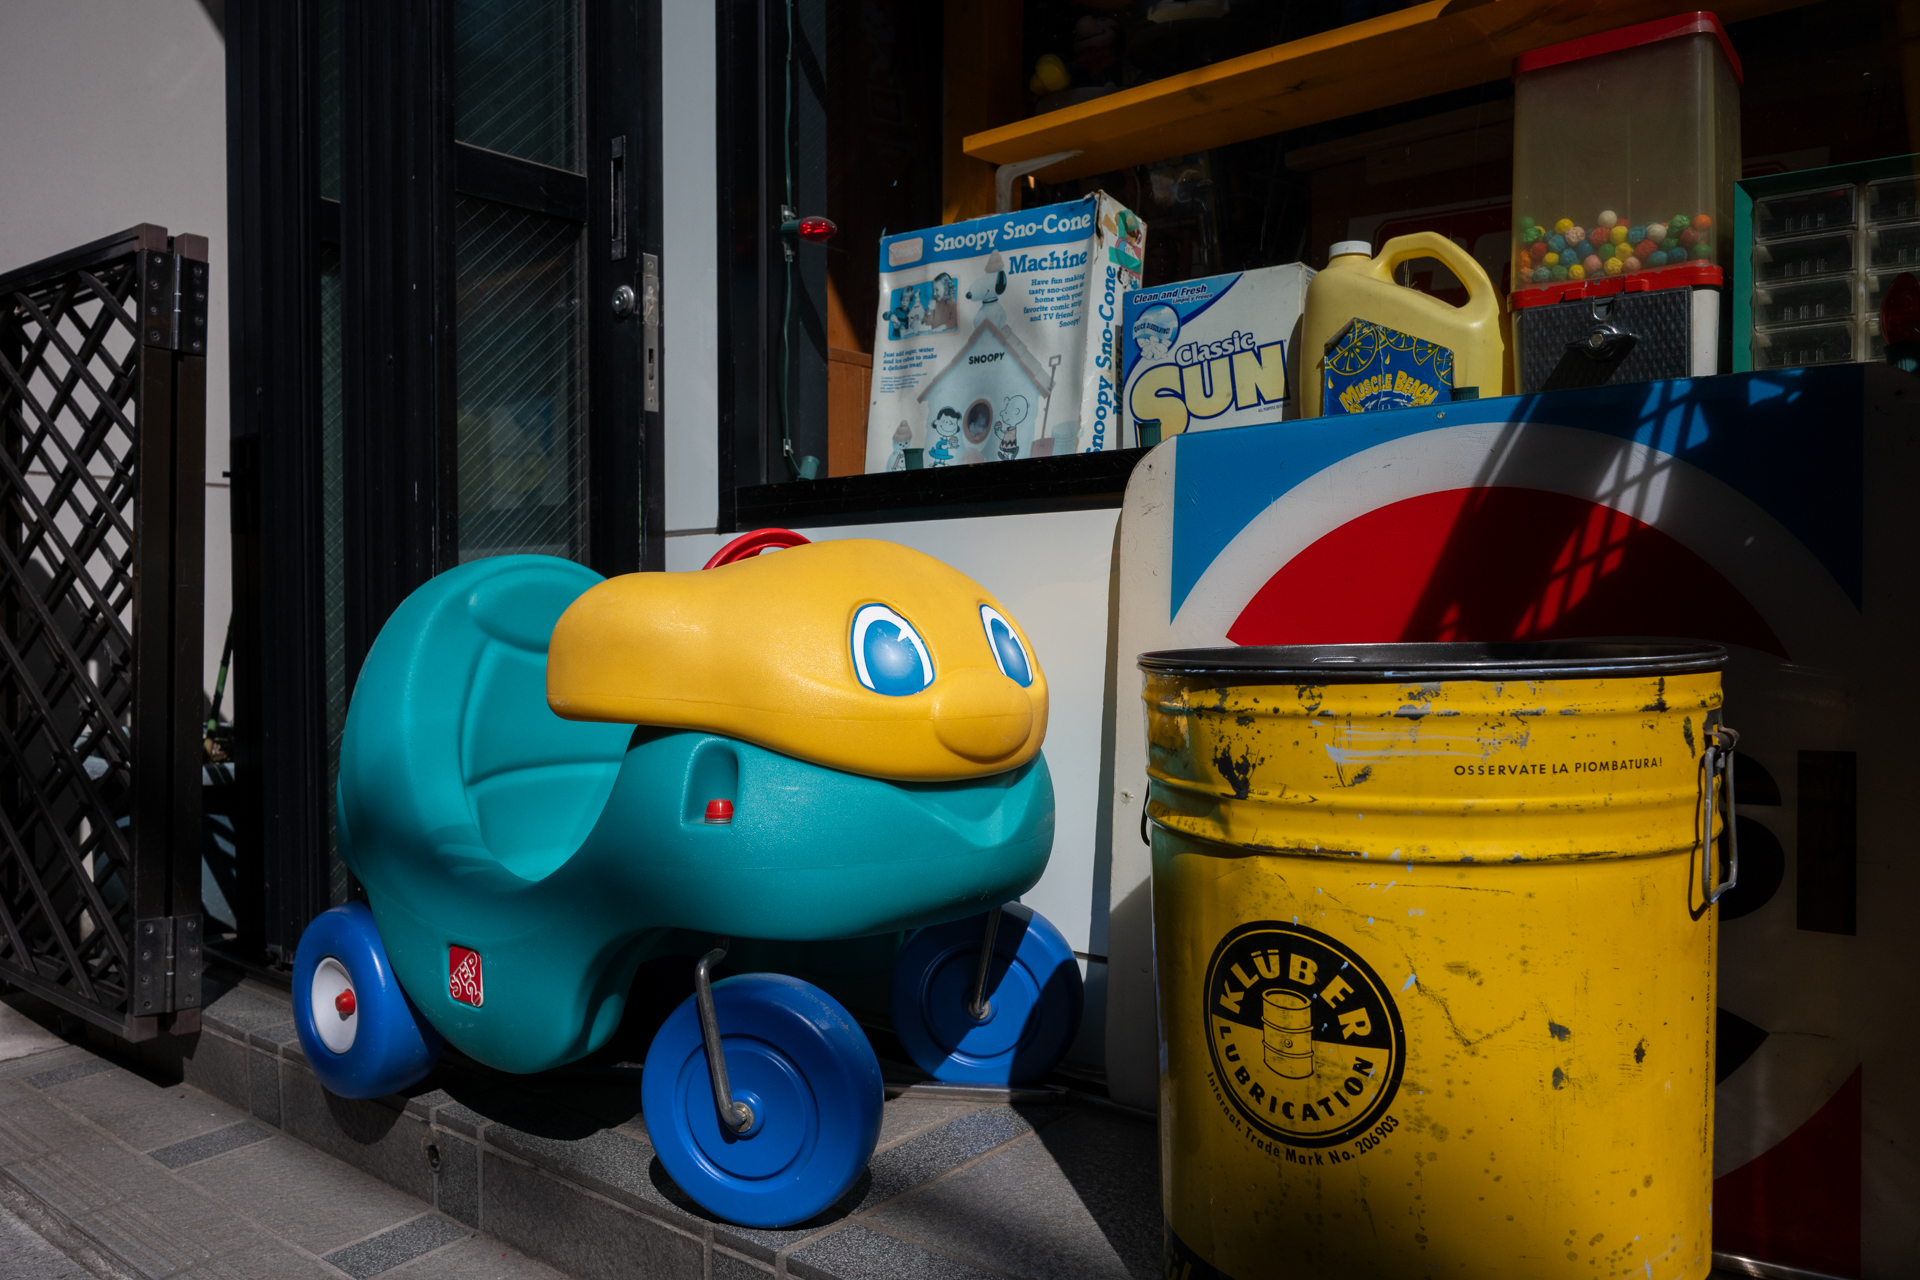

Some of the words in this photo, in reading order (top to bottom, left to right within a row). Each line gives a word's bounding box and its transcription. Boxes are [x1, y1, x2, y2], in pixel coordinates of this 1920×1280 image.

[934, 227, 999, 252] Snoopy
[1003, 213, 1091, 239] Sno-Cone
[1008, 249, 1088, 275] Machine
[1064, 272, 1086, 282] making
[1047, 284, 1079, 294] sno-cones
[1071, 291, 1084, 300] your
[1133, 291, 1159, 305] Clean
[1160, 288, 1179, 300] and
[1180, 283, 1207, 298] Fresh
[1171, 296, 1190, 305] Limpio
[1195, 292, 1214, 301] Fresco
[1023, 306, 1048, 314] favorite
[1050, 303, 1070, 311] comic
[1071, 299, 1083, 308] strip
[1096, 265, 1117, 370] Sno-Cone
[1030, 314, 1041, 322] and
[1059, 316, 1082, 328] Snoopy!
[1133, 322, 1147, 333] QUICK
[1147, 322, 1171, 335] DISSOLVING!
[968, 352, 1005, 365] SNOOPY
[1175, 330, 1256, 367] Classic
[1129, 340, 1290, 446] SUN
[1338, 372, 1393, 411] MUSCLE
[1393, 370, 1438, 405] BEACH
[1454, 763, 1547, 776] OSSERVATE
[1552, 763, 1569, 774] LA
[1575, 756, 1663, 773] PIOMBATURA!
[449, 951, 478, 998] STEP
[465, 980, 482, 1007] 2
[1219, 949, 1373, 1040] KLÜBER
[1219, 1025, 1375, 1122] LUBRICATION
[1207, 1071, 1242, 1133] Internat.
[1245, 1126, 1280, 1158] Trade
[1285, 1149, 1324, 1165] Mark
[1328, 1149, 1356, 1165] No.
[1355, 1115, 1399, 1155] 206903
